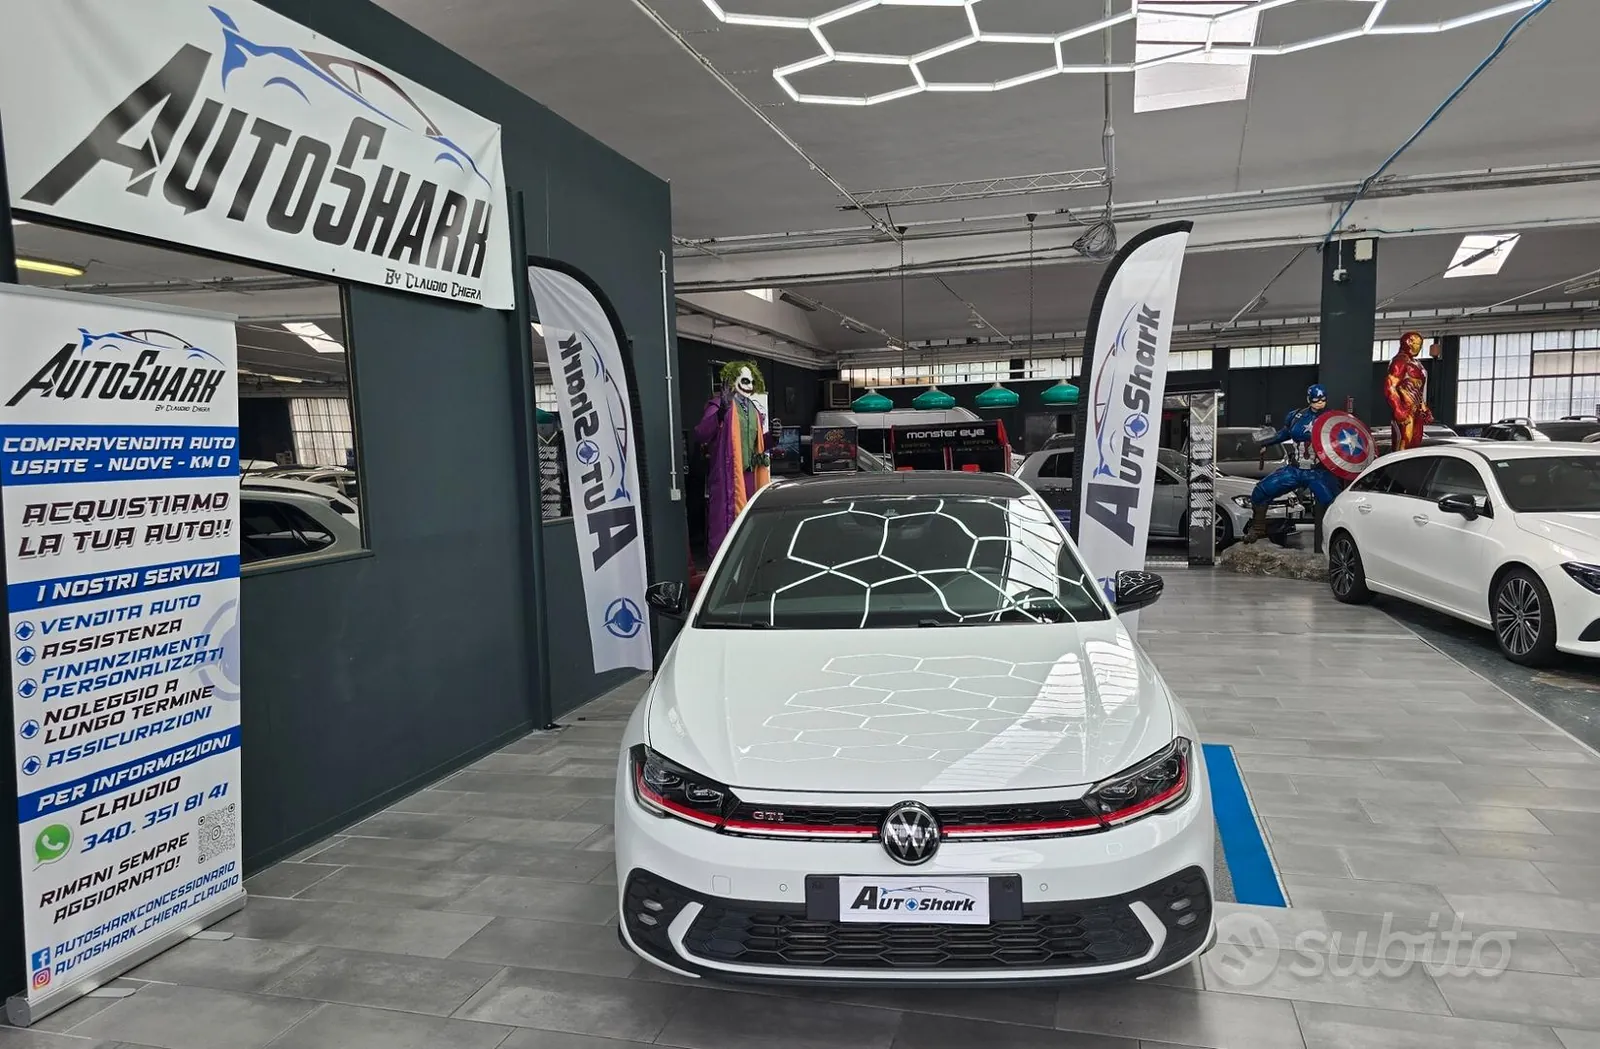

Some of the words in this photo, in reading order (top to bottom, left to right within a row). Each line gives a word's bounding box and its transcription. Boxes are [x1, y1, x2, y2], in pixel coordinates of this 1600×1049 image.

[406, 272, 448, 293] CLAUDIO
[451, 282, 482, 300] CHIERA
[3, 436, 184, 453] COMPRAVENDITA
[190, 436, 236, 450] AUTO
[906, 430, 957, 440] monster
[959, 428, 985, 438] eye
[10, 458, 89, 475] USATE
[108, 456, 174, 472] NUOVE
[190, 456, 213, 469] KM
[1189, 425, 1215, 527] BOXING
[22, 492, 230, 525] ACQUISTIAMO
[18, 533, 63, 558] LA
[73, 526, 136, 552] TUA
[144, 519, 232, 543] AUTO!!
[37, 585, 46, 602] I
[52, 572, 139, 600] NOSTRI
[144, 561, 221, 586] SERVIZI
[40, 604, 143, 635] VENDITA
[150, 594, 201, 615] AUTO
[41, 618, 183, 660] ASSISTENZA
[41, 634, 211, 684] FINANZIAMENTI
[42, 647, 224, 702] PERSONALIZZATI
[44, 684, 159, 726] NOLEGGIO
[164, 678, 179, 694] A
[44, 710, 125, 744] LUNGO
[132, 685, 215, 719] TERMINE
[46, 706, 213, 768] ASSICURAZIONI
[37, 783, 89, 812] PER
[91, 734, 232, 791] INFORMAZIONI
[80, 775, 181, 825] CLAUDIO
[142, 802, 179, 829] 351
[184, 792, 204, 812] 81
[208, 782, 229, 800] 41
[753, 811, 784, 821] GTI
[39, 865, 113, 908] RIMANI
[118, 832, 190, 875] SEMPRE
[53, 855, 181, 924] AGGIORNATO!
[54, 860, 236, 958] AUTOSHARKCONCESSIONARIO
[54, 873, 239, 976] AUTOSHARK_CHIERA_CLAUDIO
